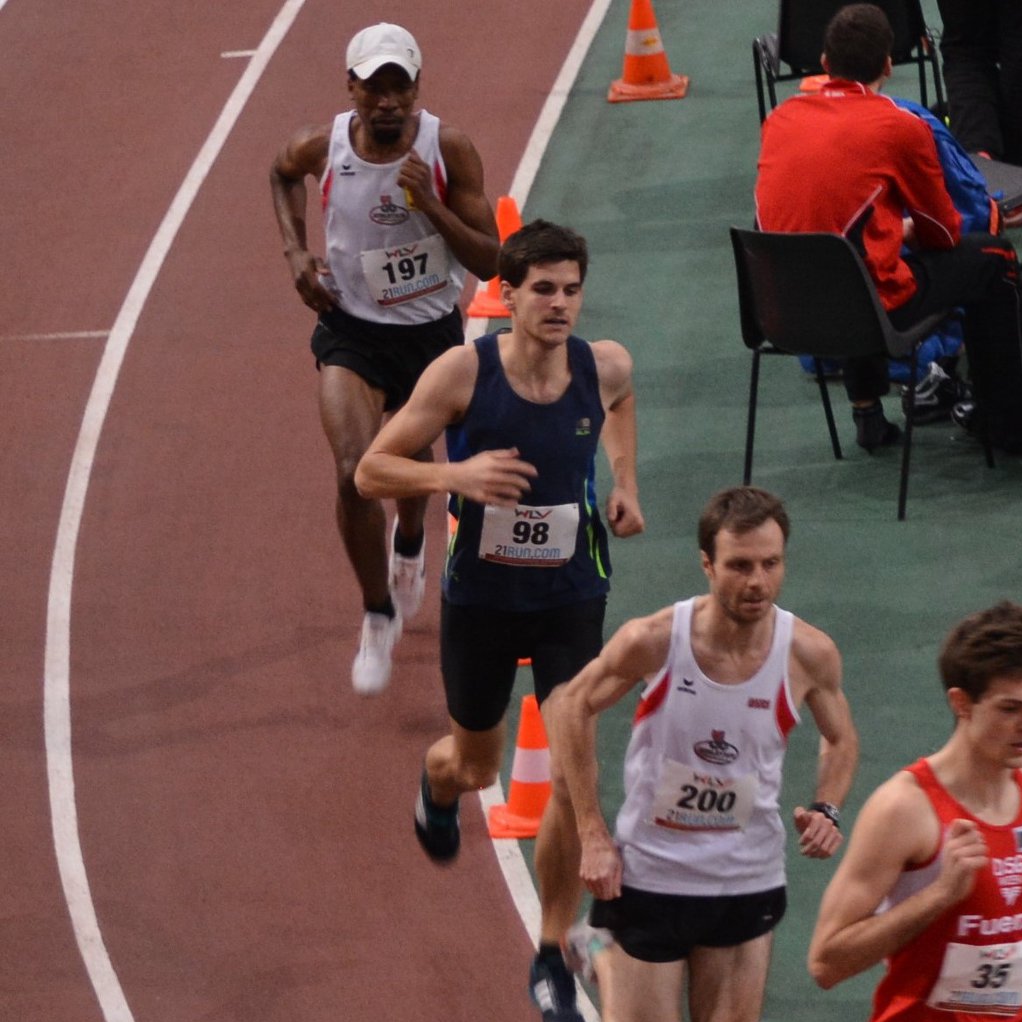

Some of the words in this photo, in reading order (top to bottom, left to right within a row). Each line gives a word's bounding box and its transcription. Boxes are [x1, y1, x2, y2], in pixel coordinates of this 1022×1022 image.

[382, 252, 428, 284] 197
[512, 520, 550, 546] 98
[676, 784, 737, 814] 200
[970, 962, 1013, 990] 35
